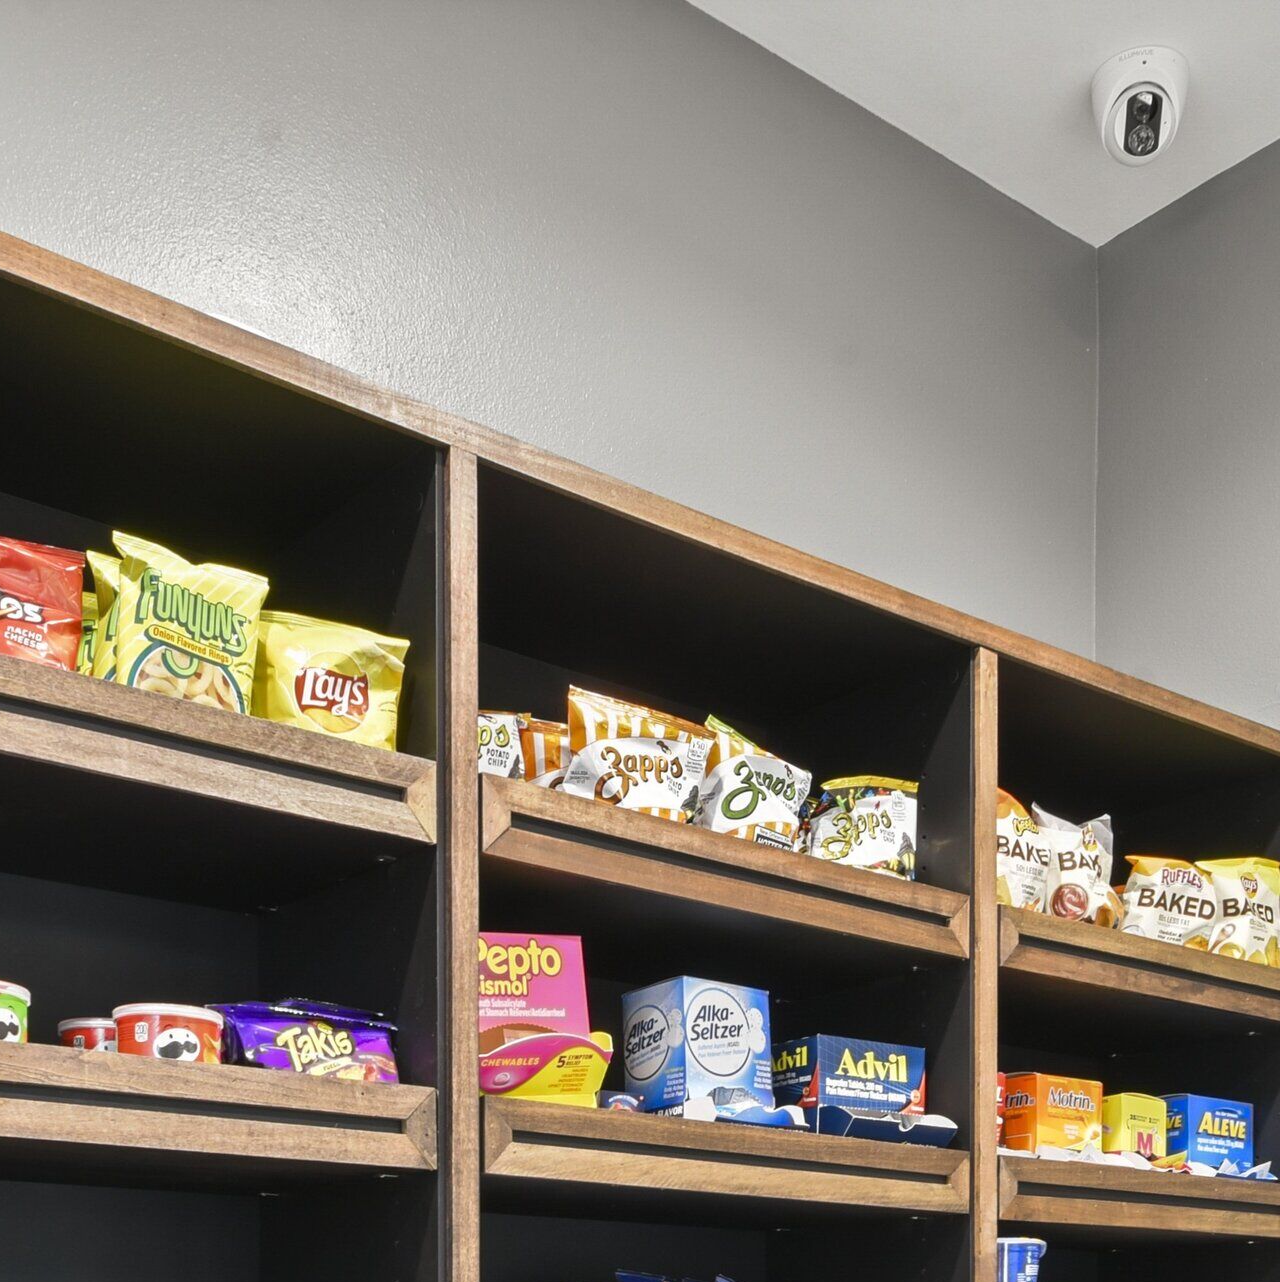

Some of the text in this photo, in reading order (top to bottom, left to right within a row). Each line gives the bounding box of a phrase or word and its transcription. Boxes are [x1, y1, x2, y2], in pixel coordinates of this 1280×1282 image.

[136, 567, 248, 657] FUNYUNS
[7, 626, 43, 641] NACHO
[152, 627, 175, 641] Onion
[177, 635, 207, 655] Flavored
[297, 667, 365, 716] Lay's
[487, 757, 508, 768] CHIPS
[997, 835, 1052, 867] BAKE
[1161, 868, 1203, 889] RUFFLES
[1137, 888, 1216, 920] BAKED
[693, 1004, 734, 1023] Alka-
[625, 1028, 666, 1059] Seltzer
[627, 1017, 659, 1043] Alka-
[690, 1023, 744, 1041] Seltzer
[276, 1026, 353, 1072] Takis
[481, 1057, 540, 1067] CHEWABLES
[556, 1055, 567, 1068] 5
[835, 1048, 908, 1083] Advil
[1048, 1086, 1090, 1110] Motrin
[1198, 1111, 1247, 1139] ALEVE
